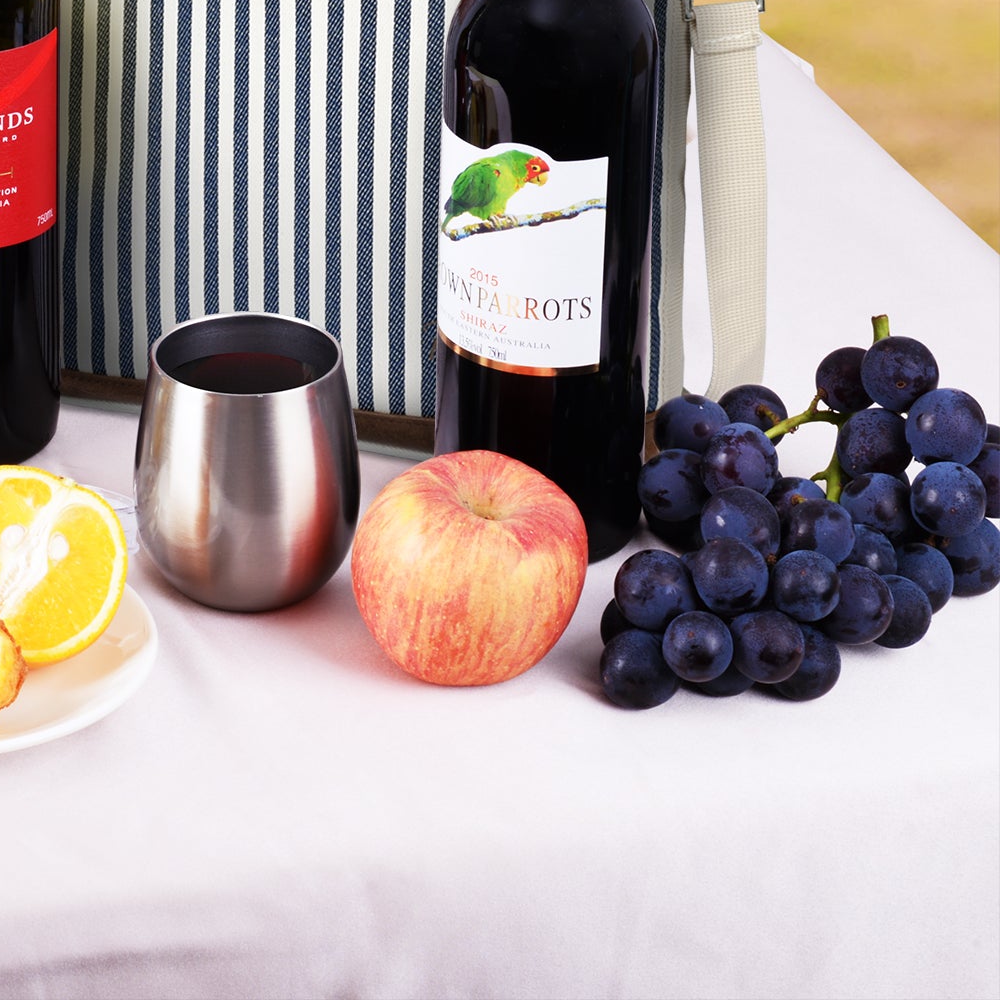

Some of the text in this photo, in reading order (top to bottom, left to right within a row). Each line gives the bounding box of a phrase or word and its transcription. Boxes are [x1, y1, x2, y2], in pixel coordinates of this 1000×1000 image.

[469, 267, 499, 287] 2015
[477, 286, 593, 322] PARROTS
[460, 310, 508, 335] SHIRAZ
[495, 335, 552, 350] AUSTRALIA
